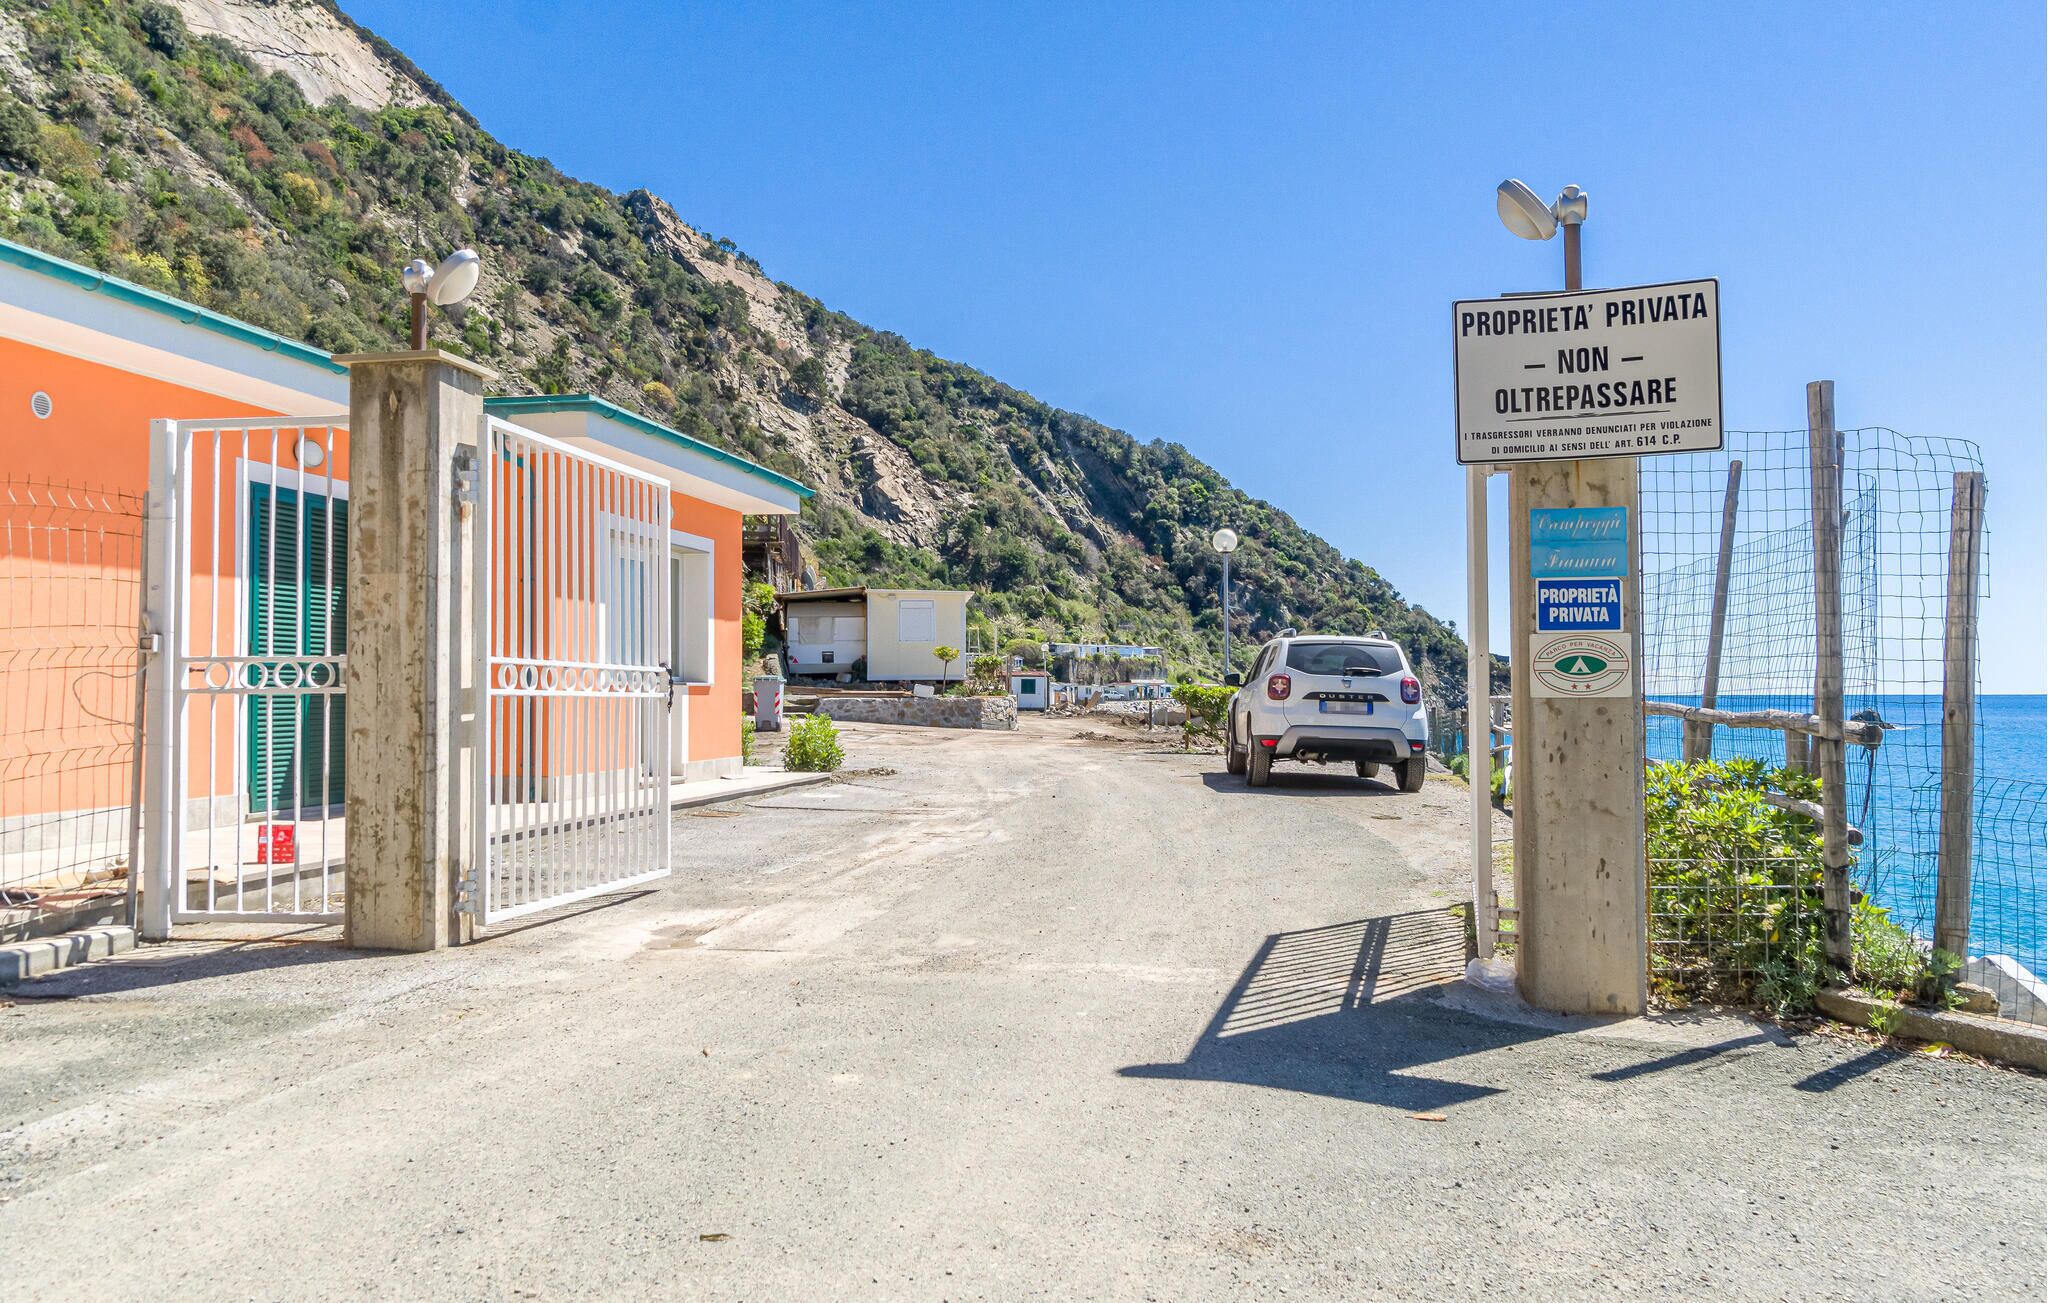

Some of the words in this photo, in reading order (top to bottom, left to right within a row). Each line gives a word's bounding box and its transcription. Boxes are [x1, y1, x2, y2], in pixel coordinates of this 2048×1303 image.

[1462, 304, 1594, 337] PROPRIETA'
[1606, 292, 1708, 328] PRIVATA
[1557, 346, 1609, 374] NON
[1495, 377, 1677, 414] OLTREPASSARE
[1464, 433, 1467, 441] I
[1471, 429, 1533, 441] TRASGRESSORI
[1536, 426, 1582, 438] VERRANNO
[1585, 423, 1637, 435] DENUNCIATI
[1640, 421, 1656, 432] PER
[1660, 418, 1712, 429] VIOLAZIONE
[1491, 445, 1500, 455] DI
[1503, 443, 1545, 455] DOMICILIO
[1549, 443, 1558, 452] AI
[1561, 441, 1586, 452] SENSI
[1589, 440, 1611, 450] DELL'
[1615, 438, 1634, 449] ART.
[1636, 434, 1657, 447] 614
[1662, 434, 1681, 446] C.P.
[1540, 584, 1618, 604] PROPRIETÀ
[1549, 606, 1610, 623] PRIVATA
[1545, 643, 1567, 657] PARCO
